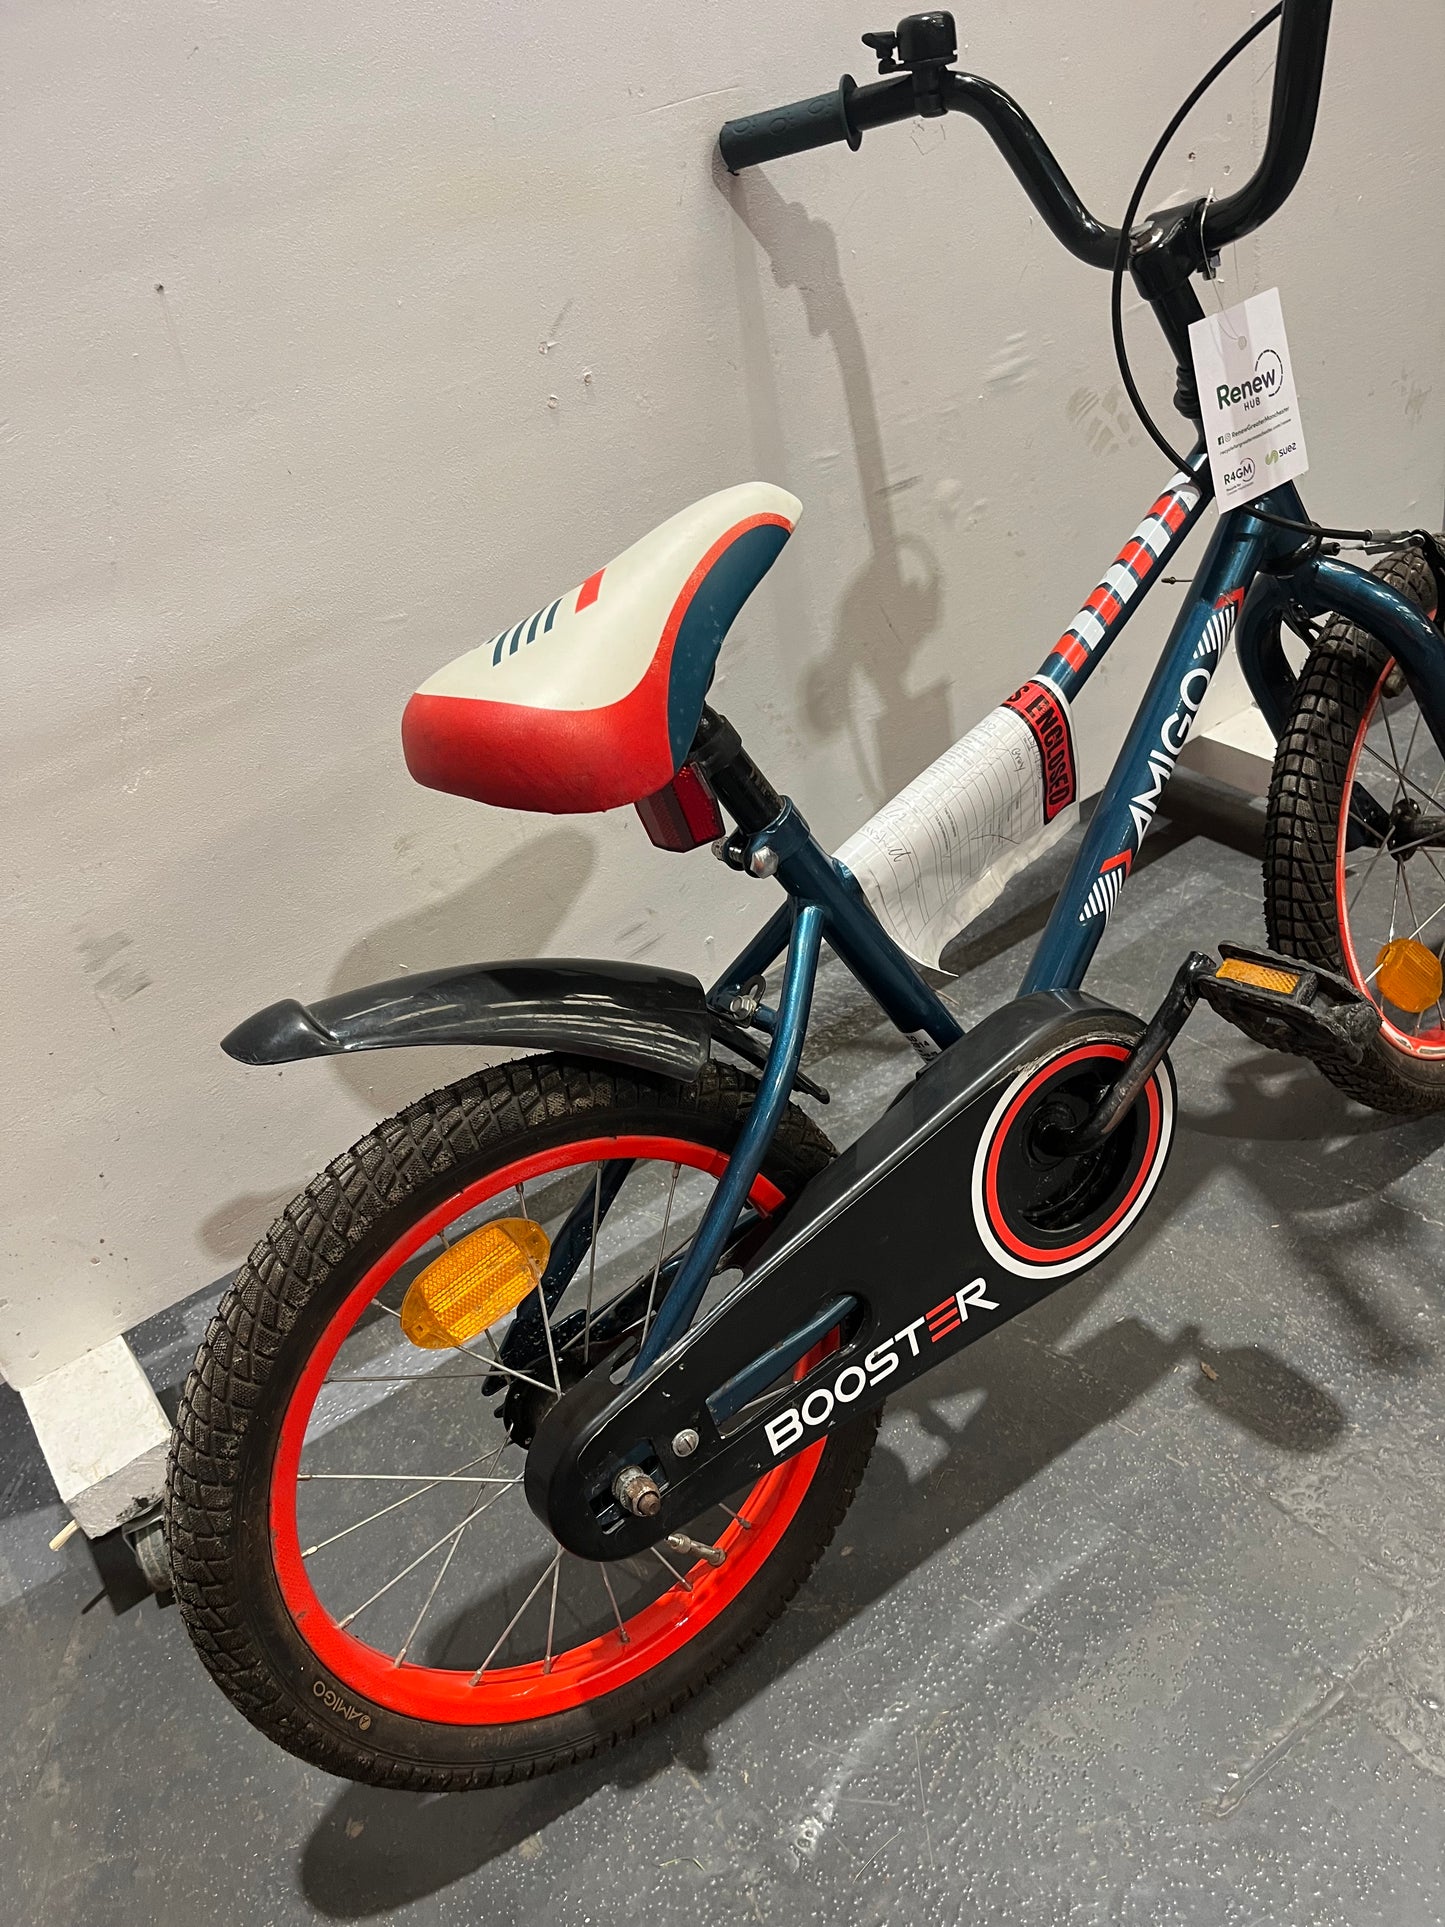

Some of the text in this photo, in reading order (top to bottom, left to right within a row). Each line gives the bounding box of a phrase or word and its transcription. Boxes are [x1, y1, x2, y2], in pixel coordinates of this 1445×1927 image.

[1216, 369, 1275, 411] Renew
[1244, 397, 1261, 411] HUB
[1278, 442, 1297, 458] suez
[1223, 464, 1253, 485] R4GM
[1024, 694, 1070, 806] ENCLOSED
[1129, 668, 1211, 851] AMIGO
[764, 1277, 1000, 1456] BOOSTER
[313, 1680, 363, 1721] AMIGO
